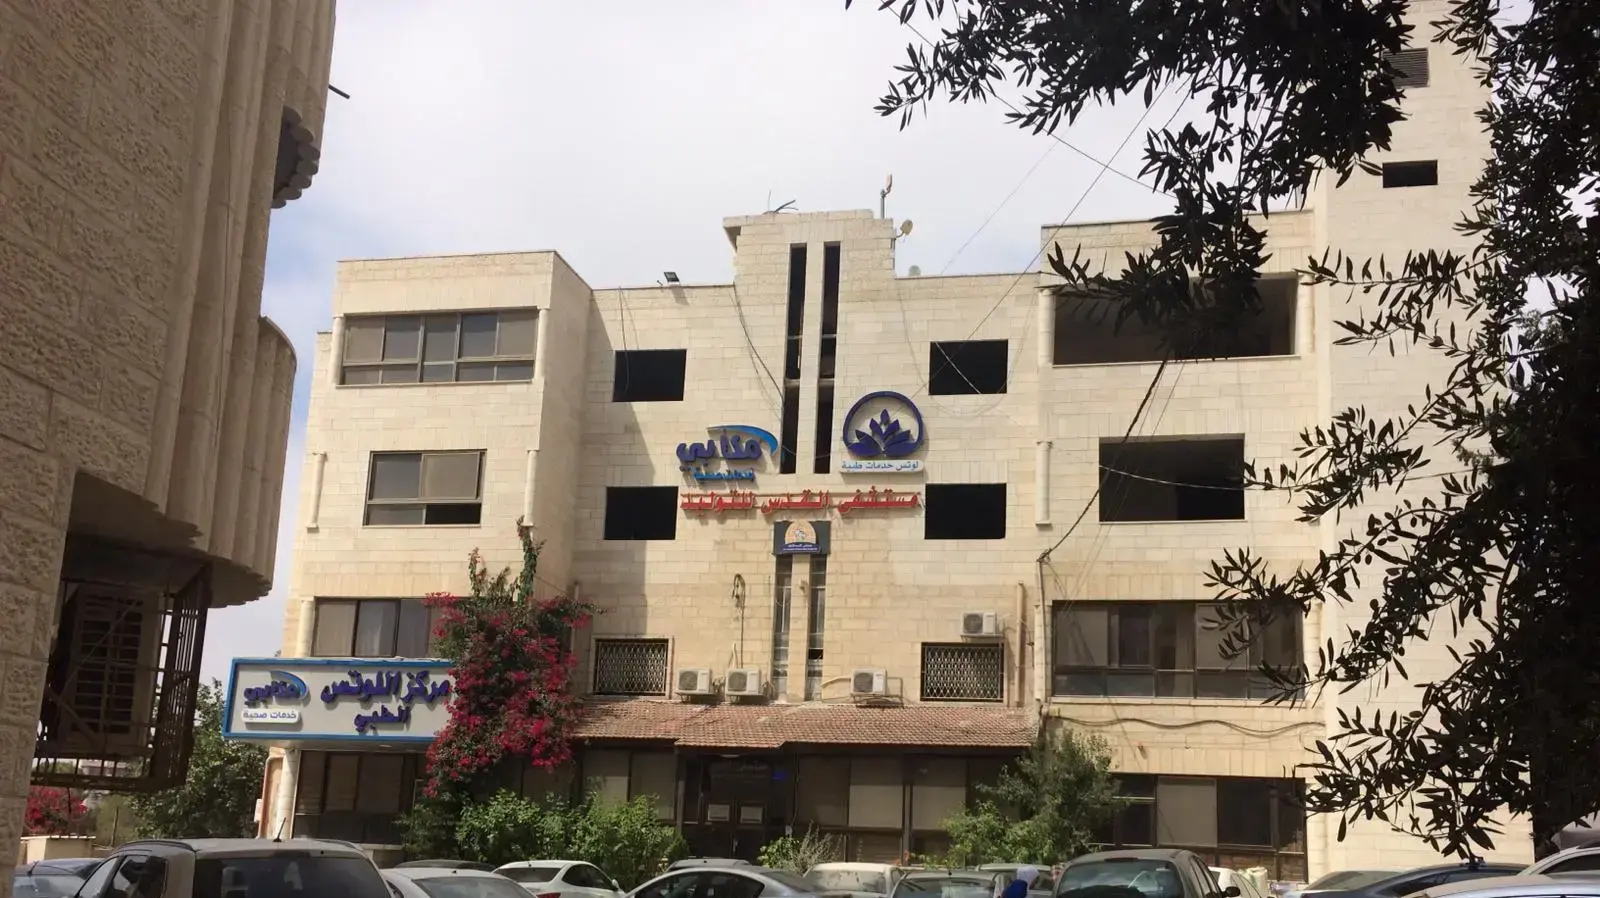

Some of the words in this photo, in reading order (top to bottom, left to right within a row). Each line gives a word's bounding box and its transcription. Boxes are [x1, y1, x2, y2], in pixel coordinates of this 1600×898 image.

[841, 461, 863, 471] طبية
[896, 461, 919, 471] لوتس
[680, 491, 754, 516] للتوليد
[761, 489, 829, 514] القدس
[838, 486, 919, 513] مستشفى
[321, 670, 401, 703] اللوتس
[400, 670, 450, 703] مركز
[243, 711, 268, 720] صحية
[270, 710, 297, 719] خدمات
[354, 705, 411, 732] الطبي
